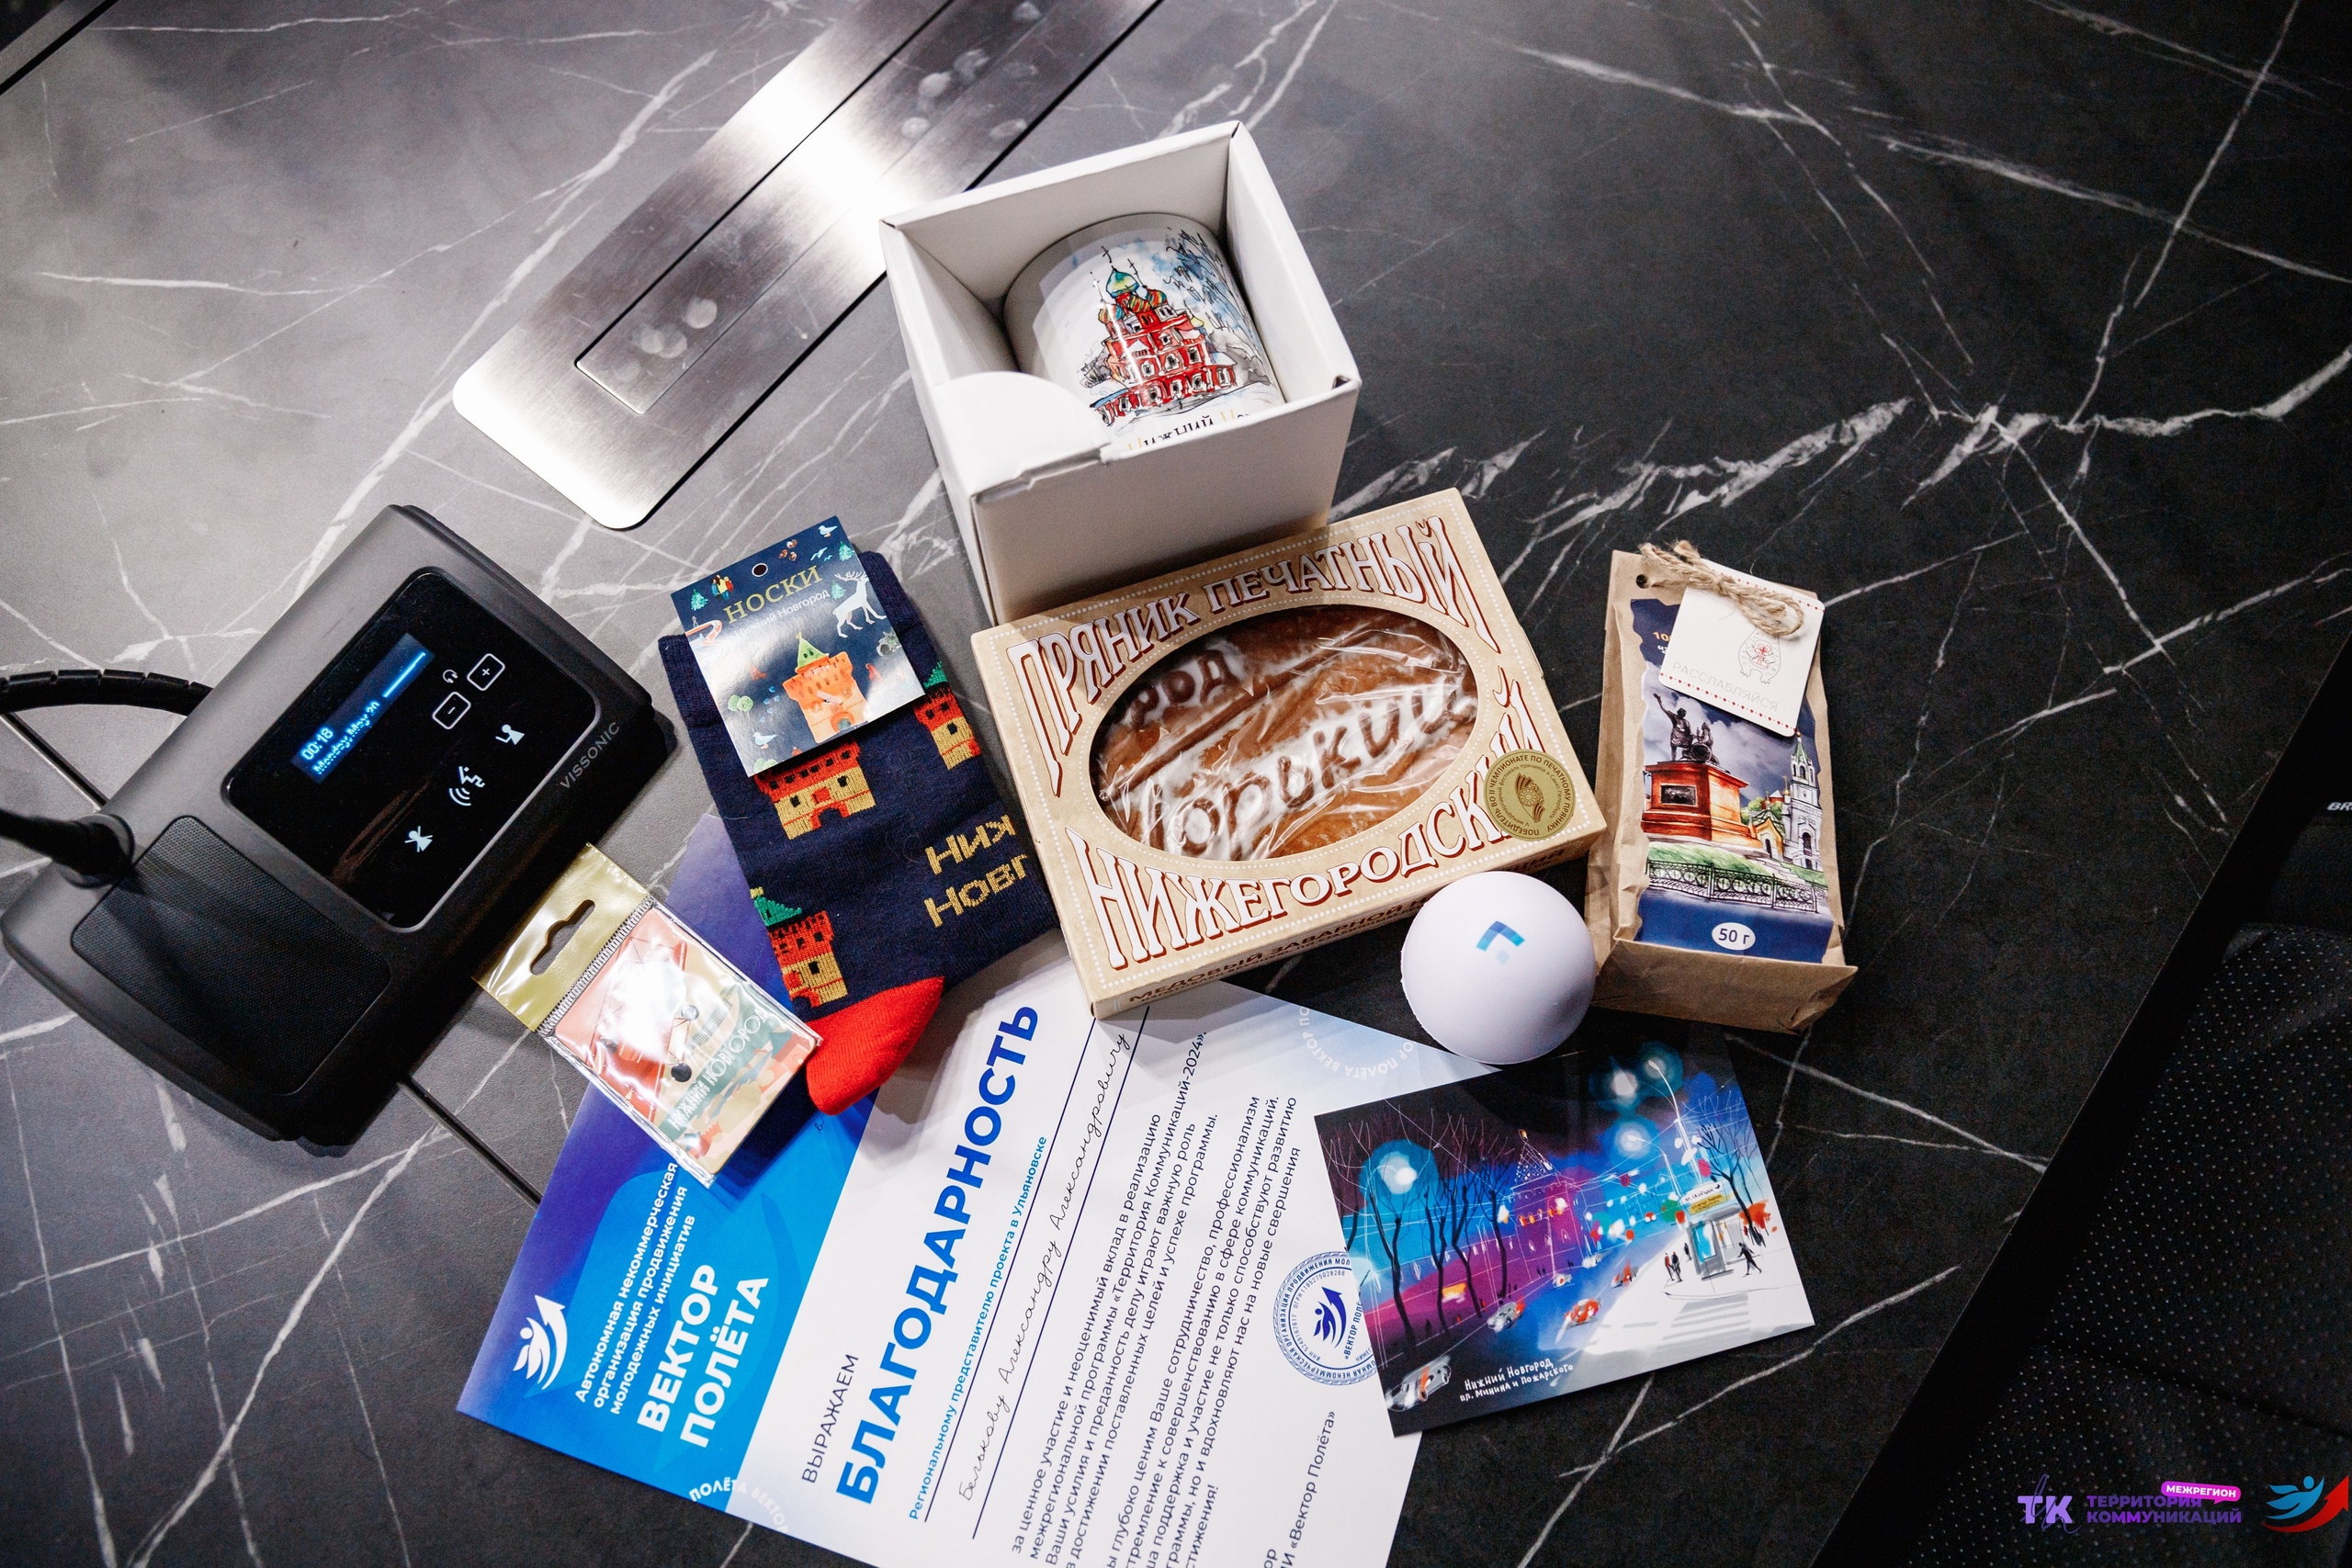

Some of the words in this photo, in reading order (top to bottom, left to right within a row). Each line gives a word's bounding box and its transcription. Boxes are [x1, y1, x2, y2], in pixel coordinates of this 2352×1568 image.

[723, 564, 823, 626] НОСКИ
[777, 588, 830, 619] Новгород
[1007, 592, 1202, 797] ПРЯНИК
[1202, 513, 1501, 654] ПЕЧАТНЫЙ
[1672, 661, 1779, 712] РАССЛАБЛЯЙСЯ
[300, 727, 334, 761] 00:18
[560, 721, 621, 791] VISSONIC
[1531, 755, 1543, 763] ПО
[1489, 754, 1528, 788] ЧЕМПИОНАТЕ
[1544, 760, 1571, 801] ПЕЧАТНОМУ
[1489, 796, 1498, 807] ВО
[1495, 808, 1540, 836] ПОБЕДИТЕЛЬ
[1547, 803, 1570, 831] ПРЯНИКУ
[2327, 801, 2352, 811] BR
[1129, 950, 1262, 1003] МЕДОВЫЙ
[1271, 905, 1404, 954] ЗАВАРНОЙ
[1718, 928, 1738, 942] 50
[1743, 934, 1749, 944] г
[1299, 1006, 1310, 1027] ПО
[1302, 1032, 1341, 1072] ВЕКТОР
[1344, 1056, 1398, 1081] ПОЛЁТА
[1398, 1042, 1414, 1061] ОР
[1176, 1123, 1196, 1162] роль
[1181, 1114, 1218, 1207] программы.
[1235, 1097, 1279, 1216] коммуникаций.
[1267, 1097, 1297, 1173] развитию
[1012, 1136, 1047, 1217] Ульяновске
[1123, 1114, 1161, 1212] реализацию
[1156, 1163, 1182, 1225] важную
[1267, 1147, 1301, 1236] свершения
[1010, 1219, 1019, 1228] в
[1118, 1213, 1129, 1224] в
[1163, 1210, 1187, 1265] успехе
[1219, 1219, 1241, 1269] сфере
[1233, 1174, 1273, 1285] способствуют
[835, 1006, 1038, 1505] БЛАГОДАРНОСТЬ
[989, 1230, 1015, 1288] проекта
[1102, 1226, 1127, 1273] вклад
[1136, 1227, 1162, 1286] играют
[1159, 1266, 1170, 1278] и
[1250, 1239, 1273, 1291] новые
[1287, 1258, 1331, 1292] ПРОДВИЖЕНИЯ
[574, 1300, 625, 1404] Автономная
[617, 1162, 678, 1299] некоммерческая
[594, 1300, 644, 1408] организация
[637, 1186, 688, 1299] продвижения
[1030, 1404, 1087, 1560] межрегиональной
[1080, 1306, 1118, 1401] программы
[1112, 1201, 1152, 1303] «Территория
[1143, 1032, 1207, 1198] Коммуникаций-2024».
[1215, 1271, 1226, 1281] в
[610, 1305, 662, 1415] молодежных
[654, 1214, 695, 1305] инициатив
[1068, 1276, 1109, 1382] неоценимый
[1112, 1484, 1139, 1551] глубоко
[1134, 1427, 1158, 1482] ценим
[1149, 1378, 1173, 1423] Ваше
[1167, 1244, 1217, 1374] сотрудничество,
[1208, 1096, 1261, 1240] профессионализм
[1124, 1288, 1145, 1329] делу
[1142, 1280, 1165, 1330] целей
[1215, 1288, 1239, 1341] только
[1243, 1294, 1257, 1314] на
[1280, 1293, 1291, 1346] ОРГАНИЗАЦИЯ
[637, 1264, 718, 1433] ВЕКТОР
[951, 1291, 995, 1402] представителю
[1208, 1345, 1222, 1366] не
[1234, 1316, 1250, 1346] нас
[1340, 1324, 1358, 1359] «ВЕКТОР
[679, 1278, 769, 1448] ПОЛЁТА
[1089, 1330, 1130, 1437] преданность
[1161, 1284, 1221, 1456] совершенствованию
[1289, 1348, 1350, 1378] НЕКОММЕРЧЕСКАЯ
[1507, 1358, 1554, 1378] Новгород
[1062, 1385, 1074, 1397] и
[1104, 1333, 1148, 1450] поставленных
[1187, 1369, 1215, 1436] участие
[1200, 1348, 1240, 1457] вдохновляют
[801, 1353, 859, 1483] ВЫРАЖАЕМ
[1040, 1400, 1069, 1468] участие
[1183, 1437, 1193, 1449] и
[909, 1404, 957, 1520] Региональному
[1084, 1439, 1095, 1451] и
[1157, 1459, 1168, 1469] к
[1195, 1460, 1206, 1472] и
[689, 1476, 747, 1502] ПОЛЁТА
[1019, 1469, 1046, 1531] ценное
[1064, 1455, 1091, 1517] усилия
[1153, 1452, 1190, 1546] поддержка
[1188, 1475, 1202, 1496] но
[1289, 1481, 1317, 1549] «Вектор
[1307, 1411, 1336, 1478] Полёта»
[1070, 1453, 1110, 1560] достижении
[1012, 1535, 1025, 1554] за
[1045, 1517, 1070, 1565] Ваши
[1165, 1502, 1196, 1568] граммы,
